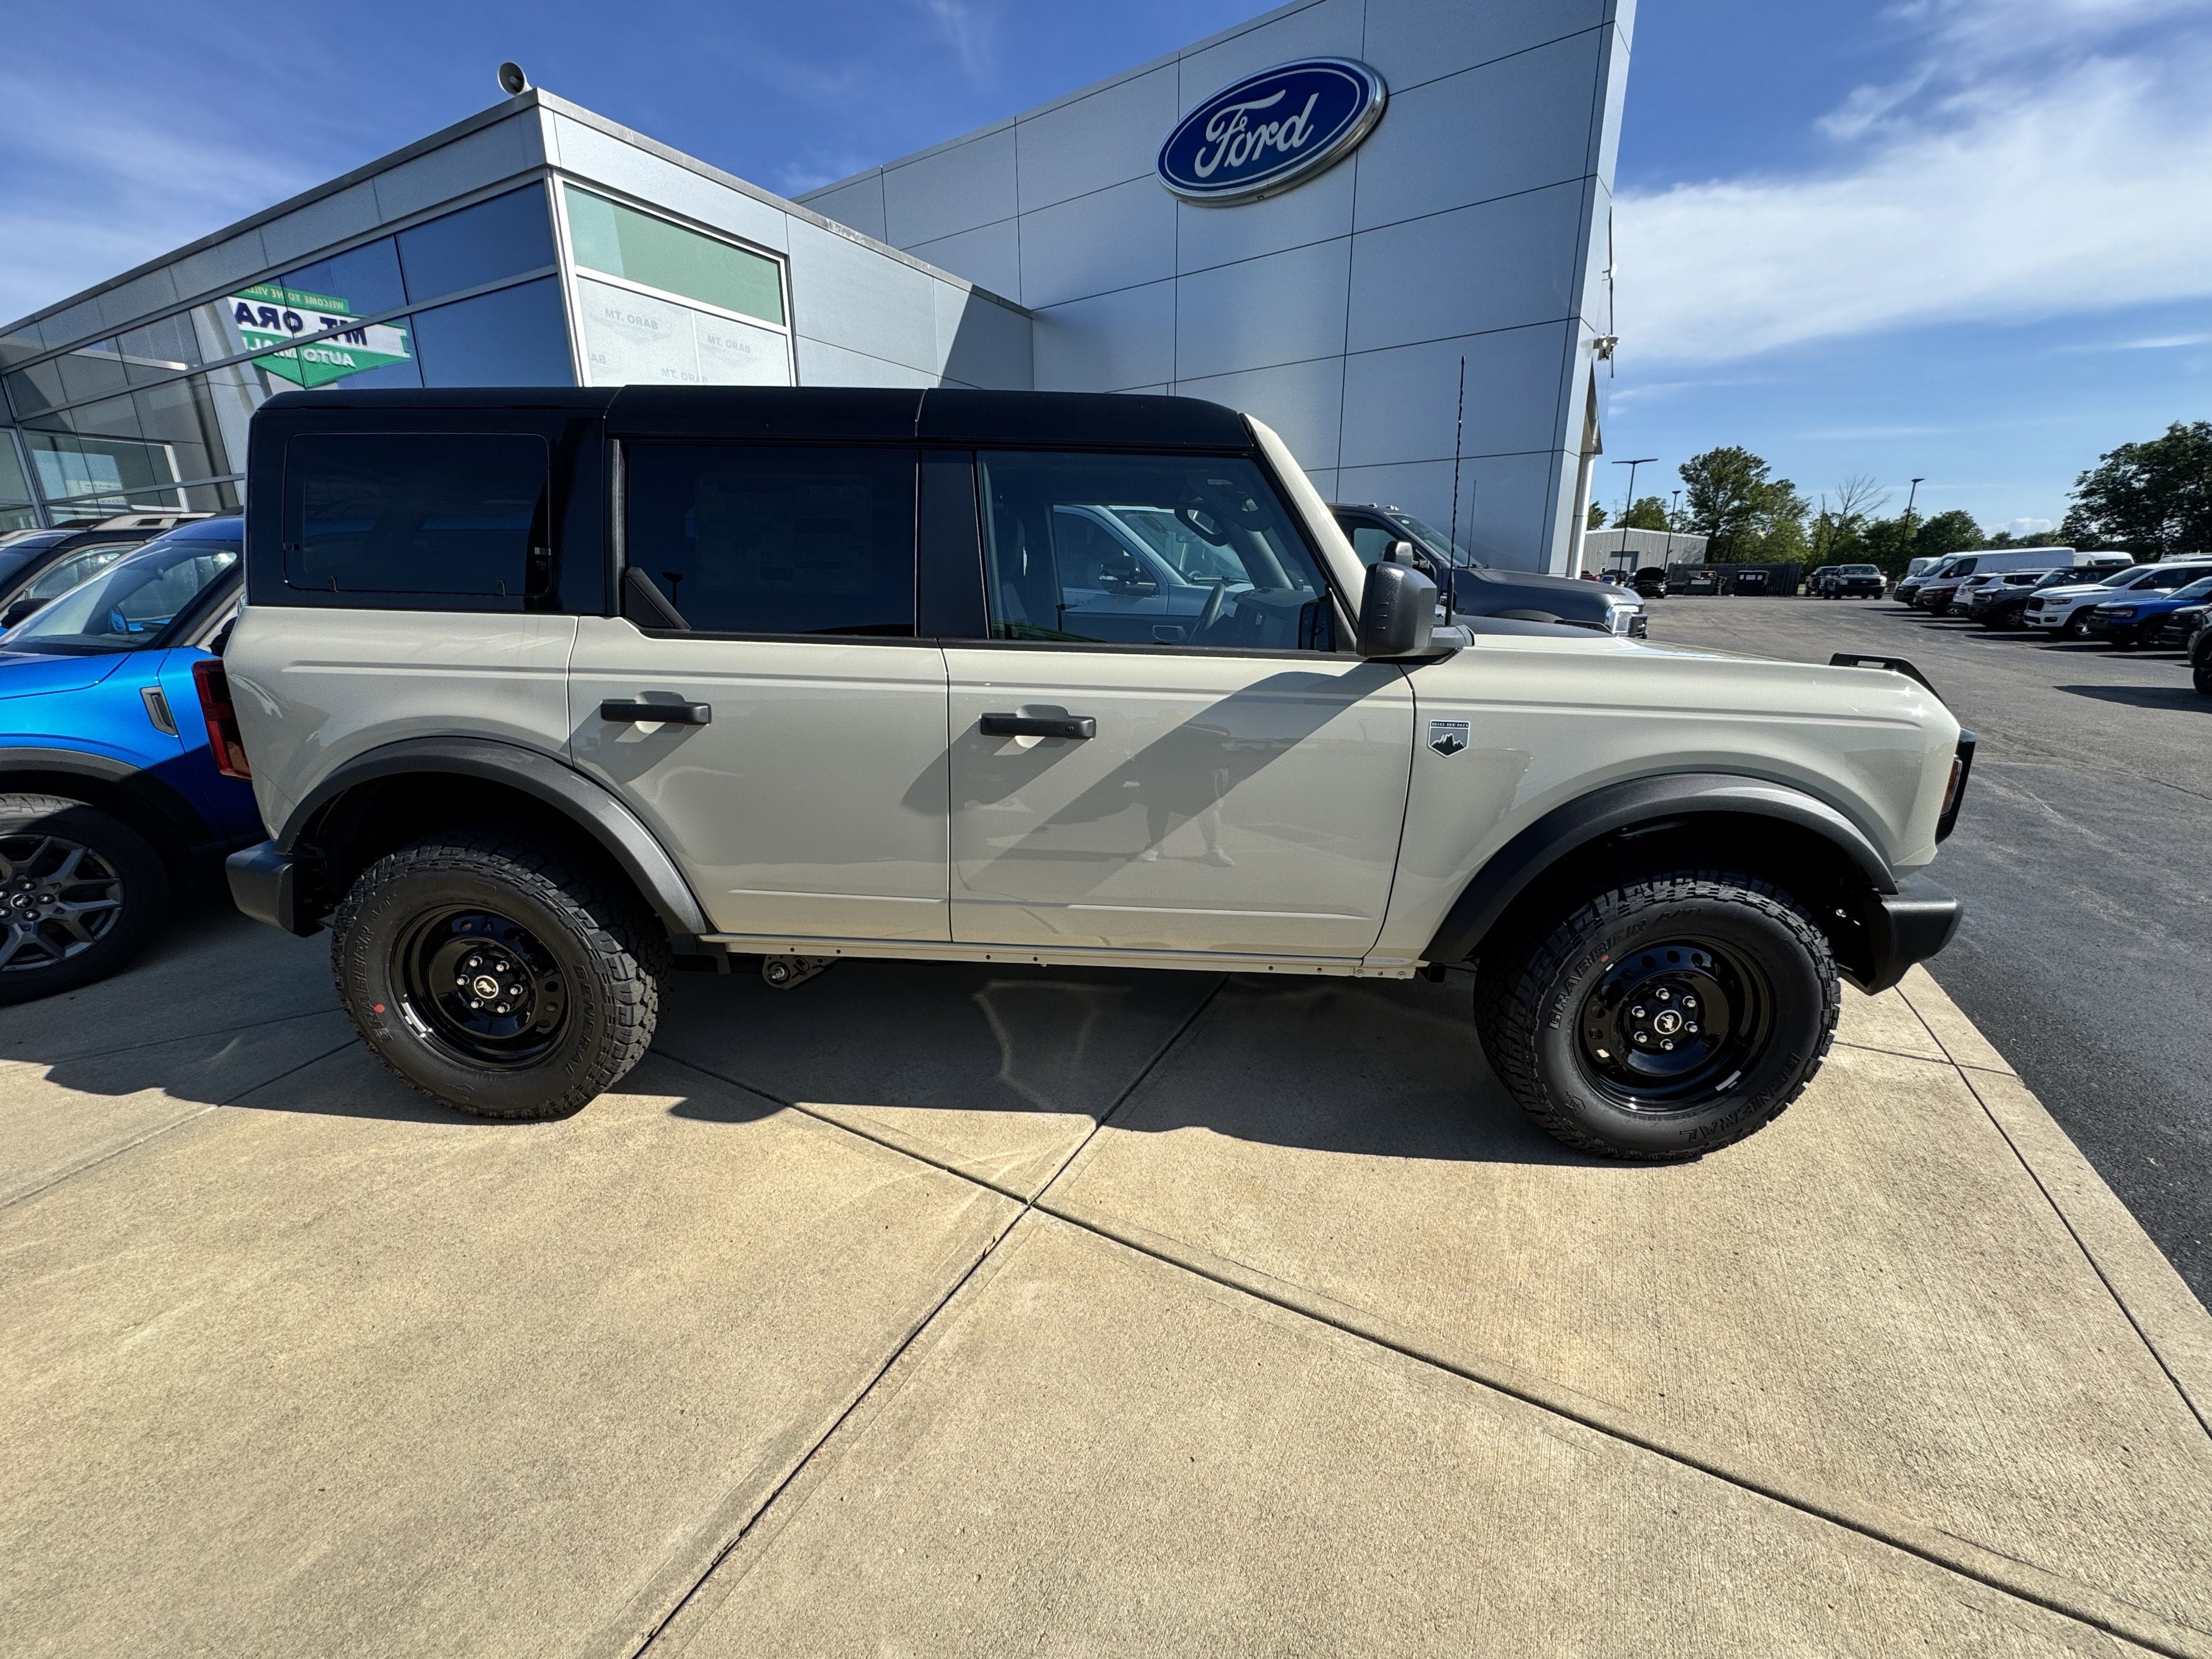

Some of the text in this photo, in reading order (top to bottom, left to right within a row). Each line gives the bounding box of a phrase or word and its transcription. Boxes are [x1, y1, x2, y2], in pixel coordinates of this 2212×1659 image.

[1194, 89, 1319, 178] Ford
[605, 308, 659, 330] MT. ORAB
[707, 334, 751, 354] MT. ORAB
[351, 925, 395, 1043] GRABBER
[565, 964, 595, 1075] GENERAL
[1549, 918, 1647, 1030] GRABBER
[1679, 1052, 1802, 1143] GENERAL
